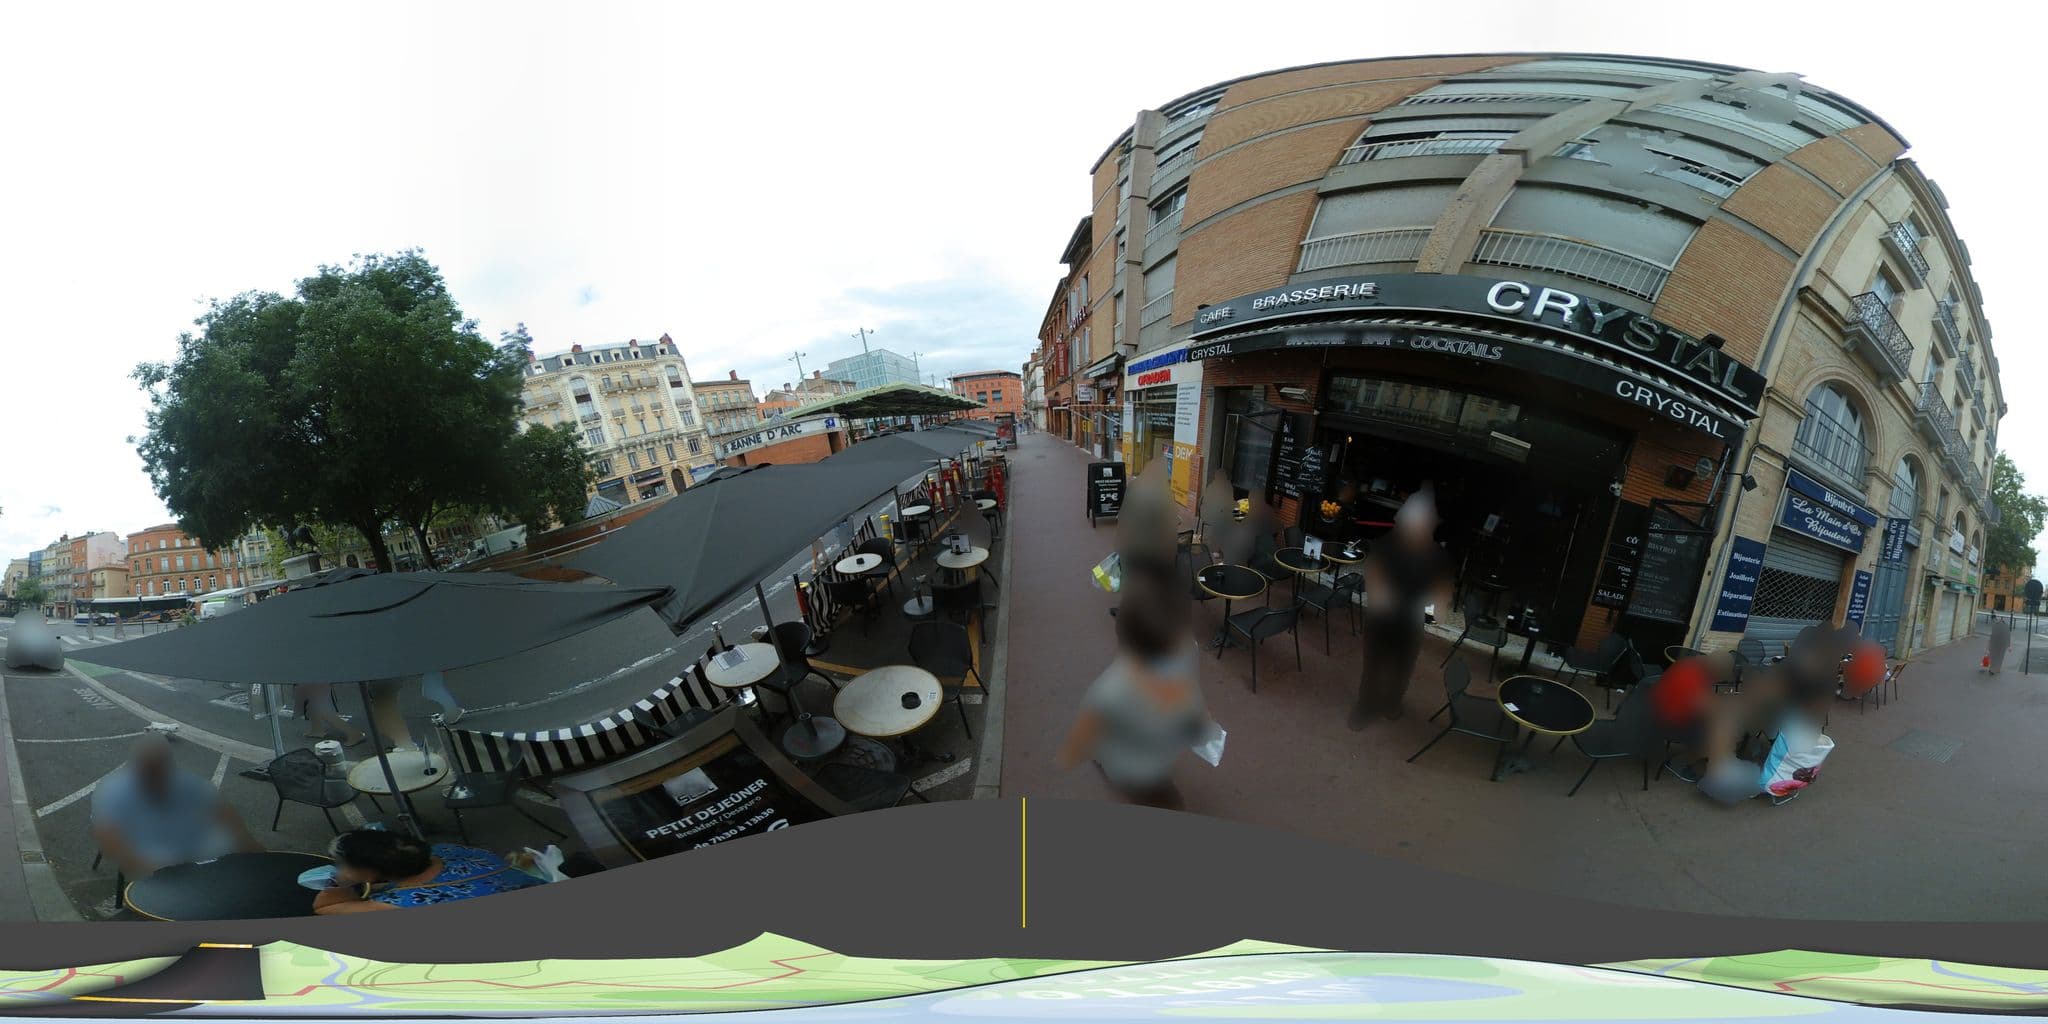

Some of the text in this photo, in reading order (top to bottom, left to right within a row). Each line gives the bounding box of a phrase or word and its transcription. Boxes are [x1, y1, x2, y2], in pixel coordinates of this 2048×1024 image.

[1253, 283, 1376, 309] BRASSERIE
[1191, 343, 1233, 361] CRYSTAL
[1410, 335, 1503, 360] COCKTAILS
[1487, 281, 1747, 398] CRYSTAL
[1616, 380, 1725, 438] CRYSTAL
[767, 424, 802, 440] D'ARC
[1792, 497, 1814, 515] La
[1815, 507, 1843, 527] Main
[1824, 491, 1856, 515] Bijouterie
[1804, 517, 1852, 544] Bijouterie
[1893, 524, 1906, 559] Bijouterie
[1733, 552, 1760, 565] Bijouterie
[1729, 572, 1755, 583] Joaillerie
[1722, 591, 1752, 601] Réparation
[1717, 609, 1748, 619] Estimation
[645, 816, 695, 839] PETIT
[694, 778, 769, 821] DEJEÛNER
[675, 818, 719, 839] Breakfast
[708, 828, 738, 845] 7h30
[736, 823, 747, 833] à
[746, 808, 775, 828] 13h30
